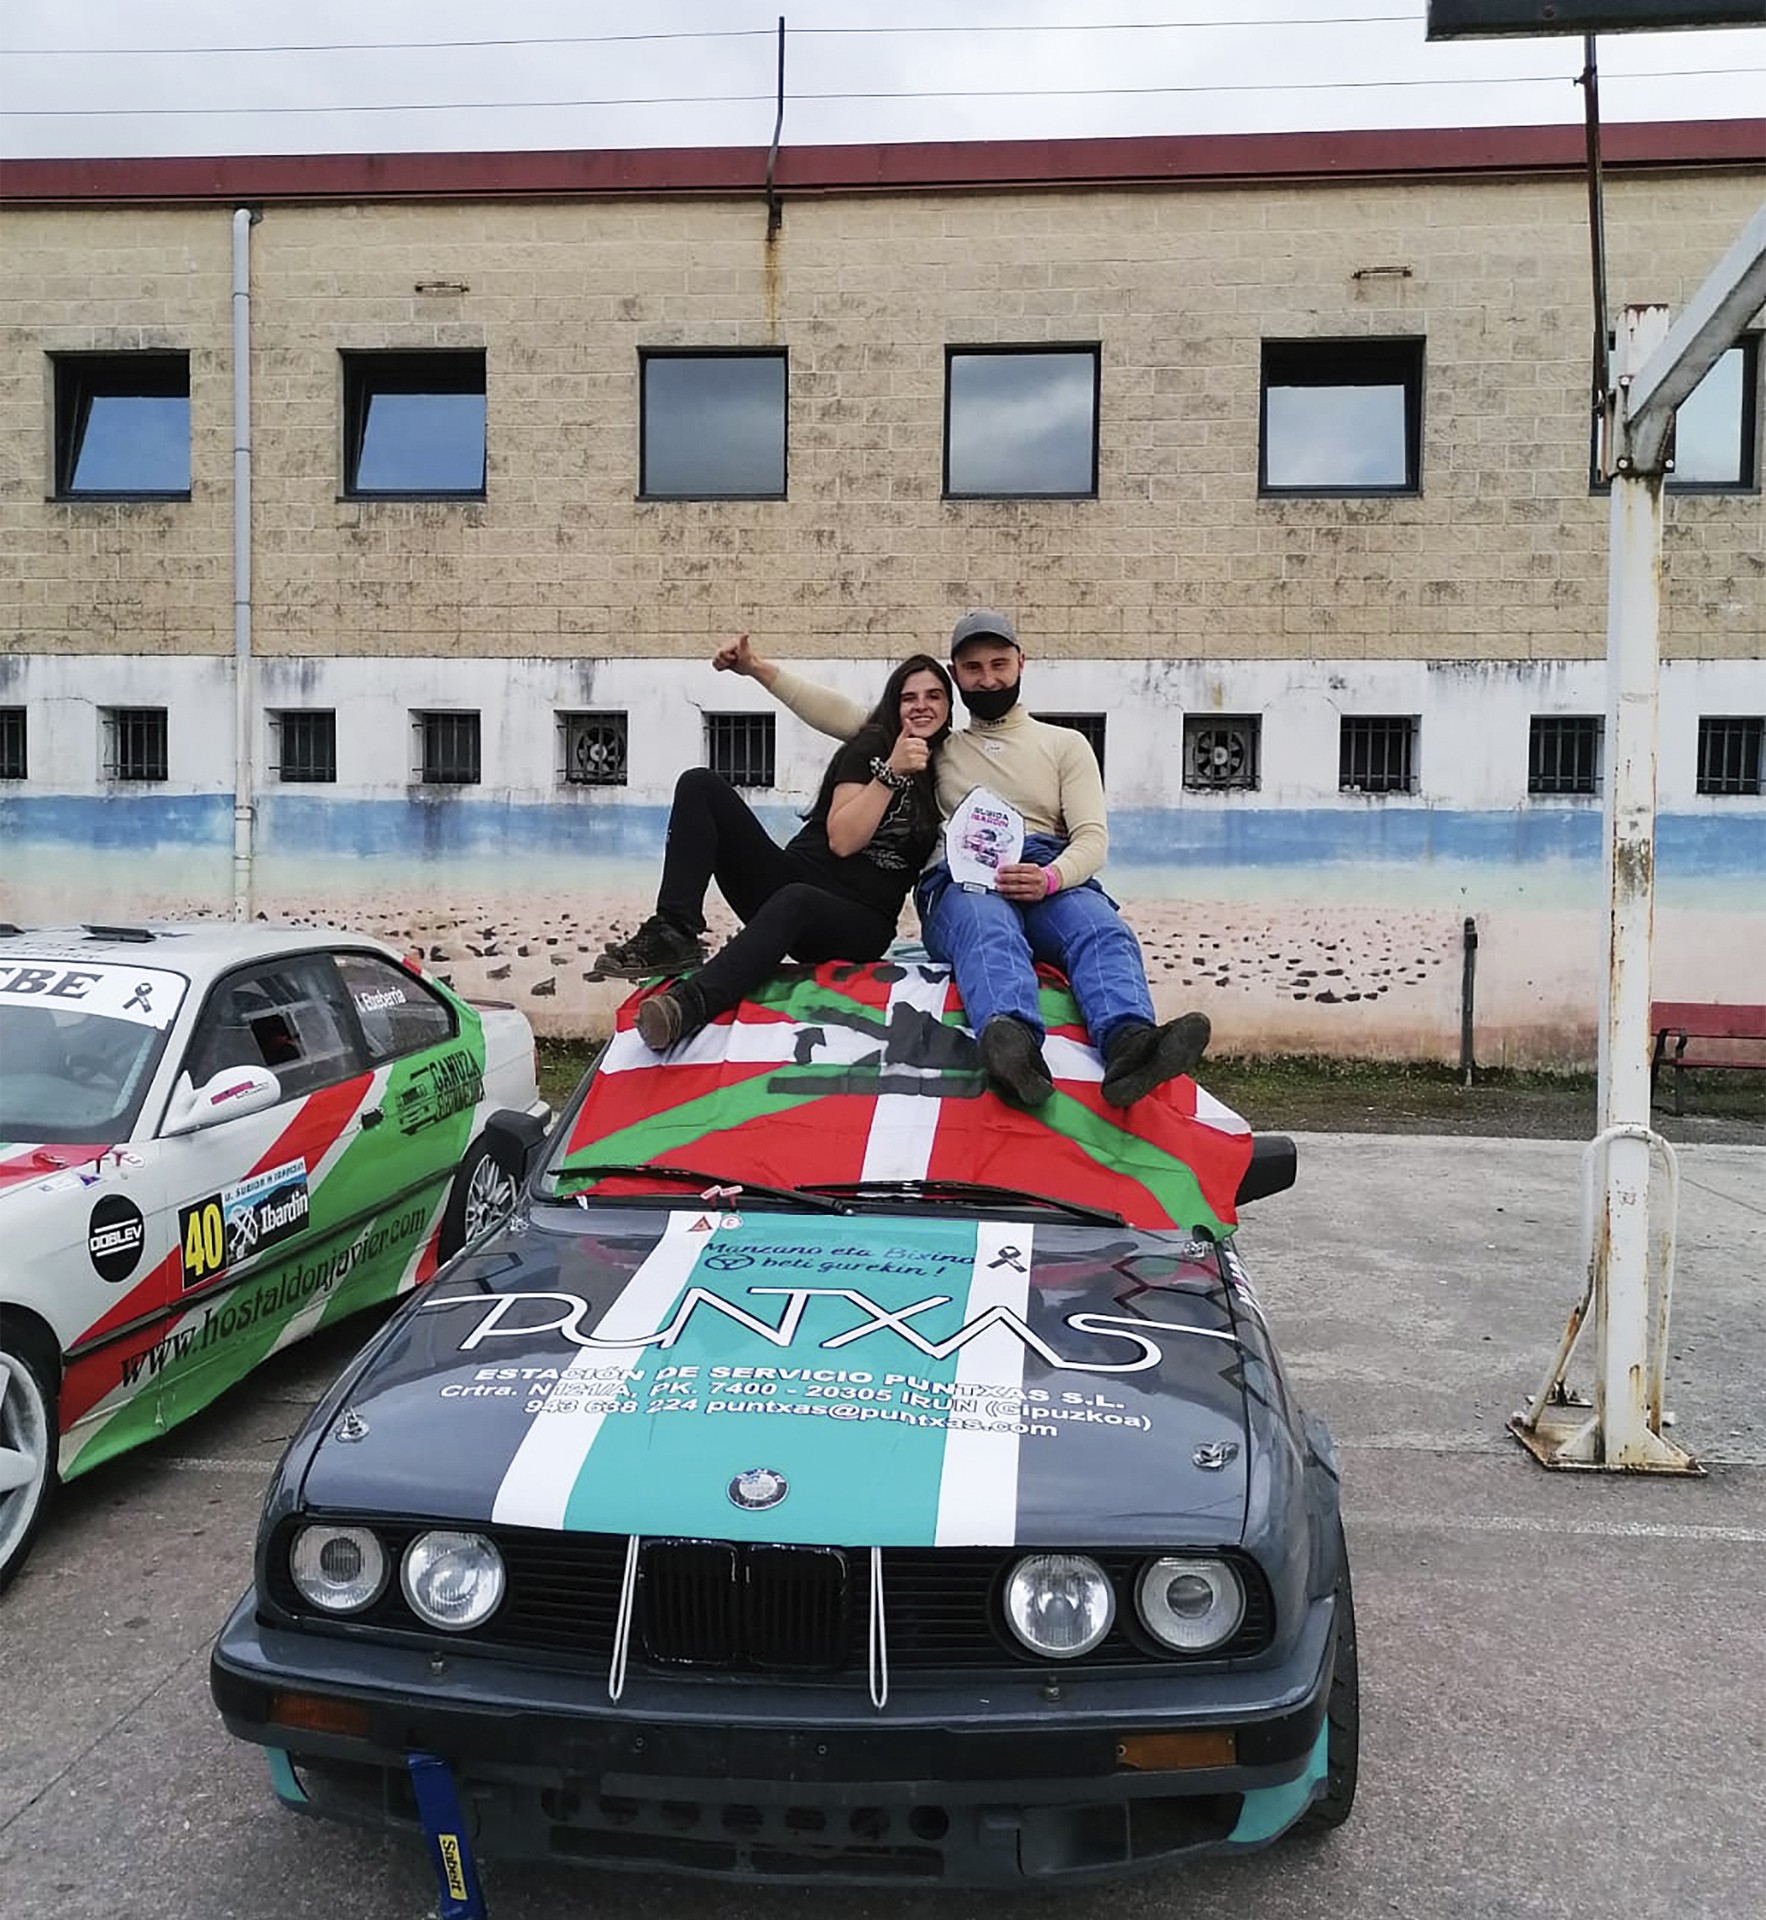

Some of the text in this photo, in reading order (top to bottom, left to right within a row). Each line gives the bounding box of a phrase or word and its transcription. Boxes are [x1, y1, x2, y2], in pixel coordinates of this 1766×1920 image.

[261, 1190, 308, 1235] Ibardin
[185, 1203, 223, 1277] 40
[761, 1257, 813, 1268] beti
[831, 1247, 870, 1257] eta
[120, 1206, 426, 1387] www.hostaldonjavier.com
[422, 1288, 1238, 1372] PUNTXAS
[440, 1384, 518, 1397] Crtra.
[650, 1382, 697, 1397] PK.
[709, 1382, 777, 1396] 7400
[805, 1385, 893, 1401] 20305
[901, 1390, 978, 1412] IRUN
[985, 1400, 1152, 1431] (Gipuzkoa)
[474, 1365, 1126, 1409] ESTACIÓN DE SERVICIO PUNTXAS S.L.
[524, 1399, 1058, 1436] 943 638 224 puntxas@puntxas.com
